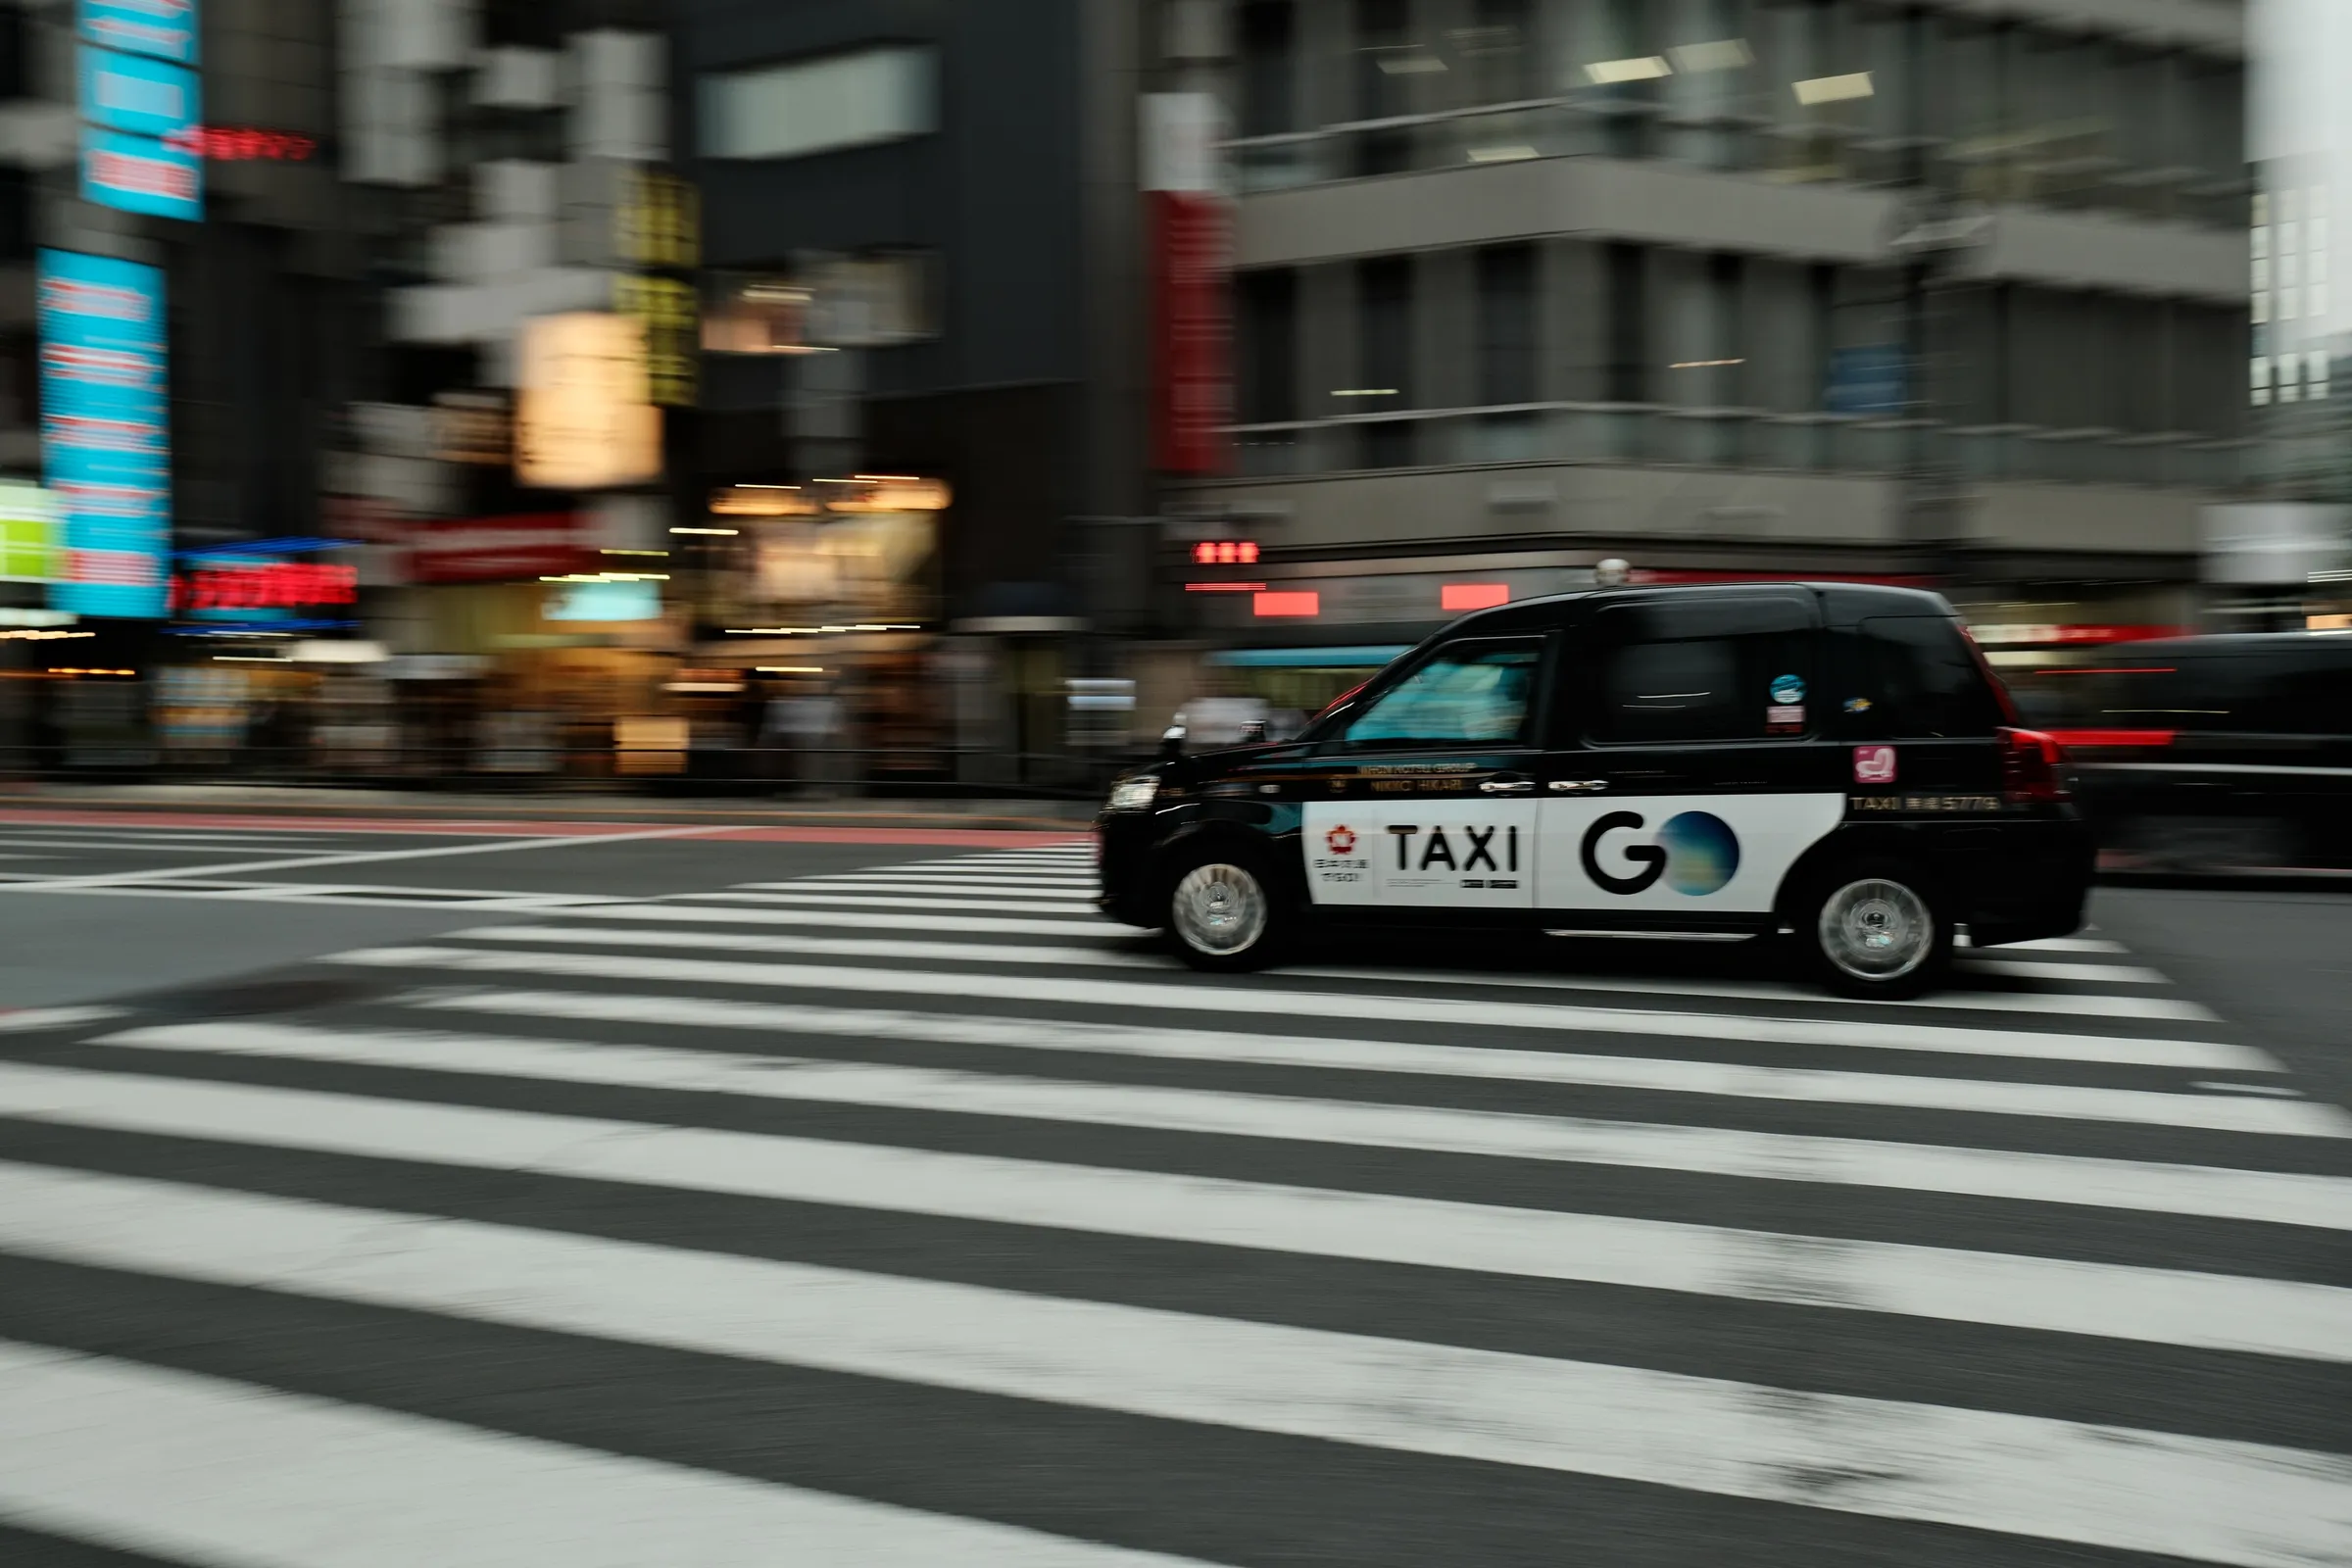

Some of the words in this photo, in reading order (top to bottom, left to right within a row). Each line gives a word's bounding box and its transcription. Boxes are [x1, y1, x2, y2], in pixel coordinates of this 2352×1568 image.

[1848, 797, 1902, 810] TAXI
[1386, 824, 1520, 872] TAXI
[1580, 810, 1740, 896] GO
